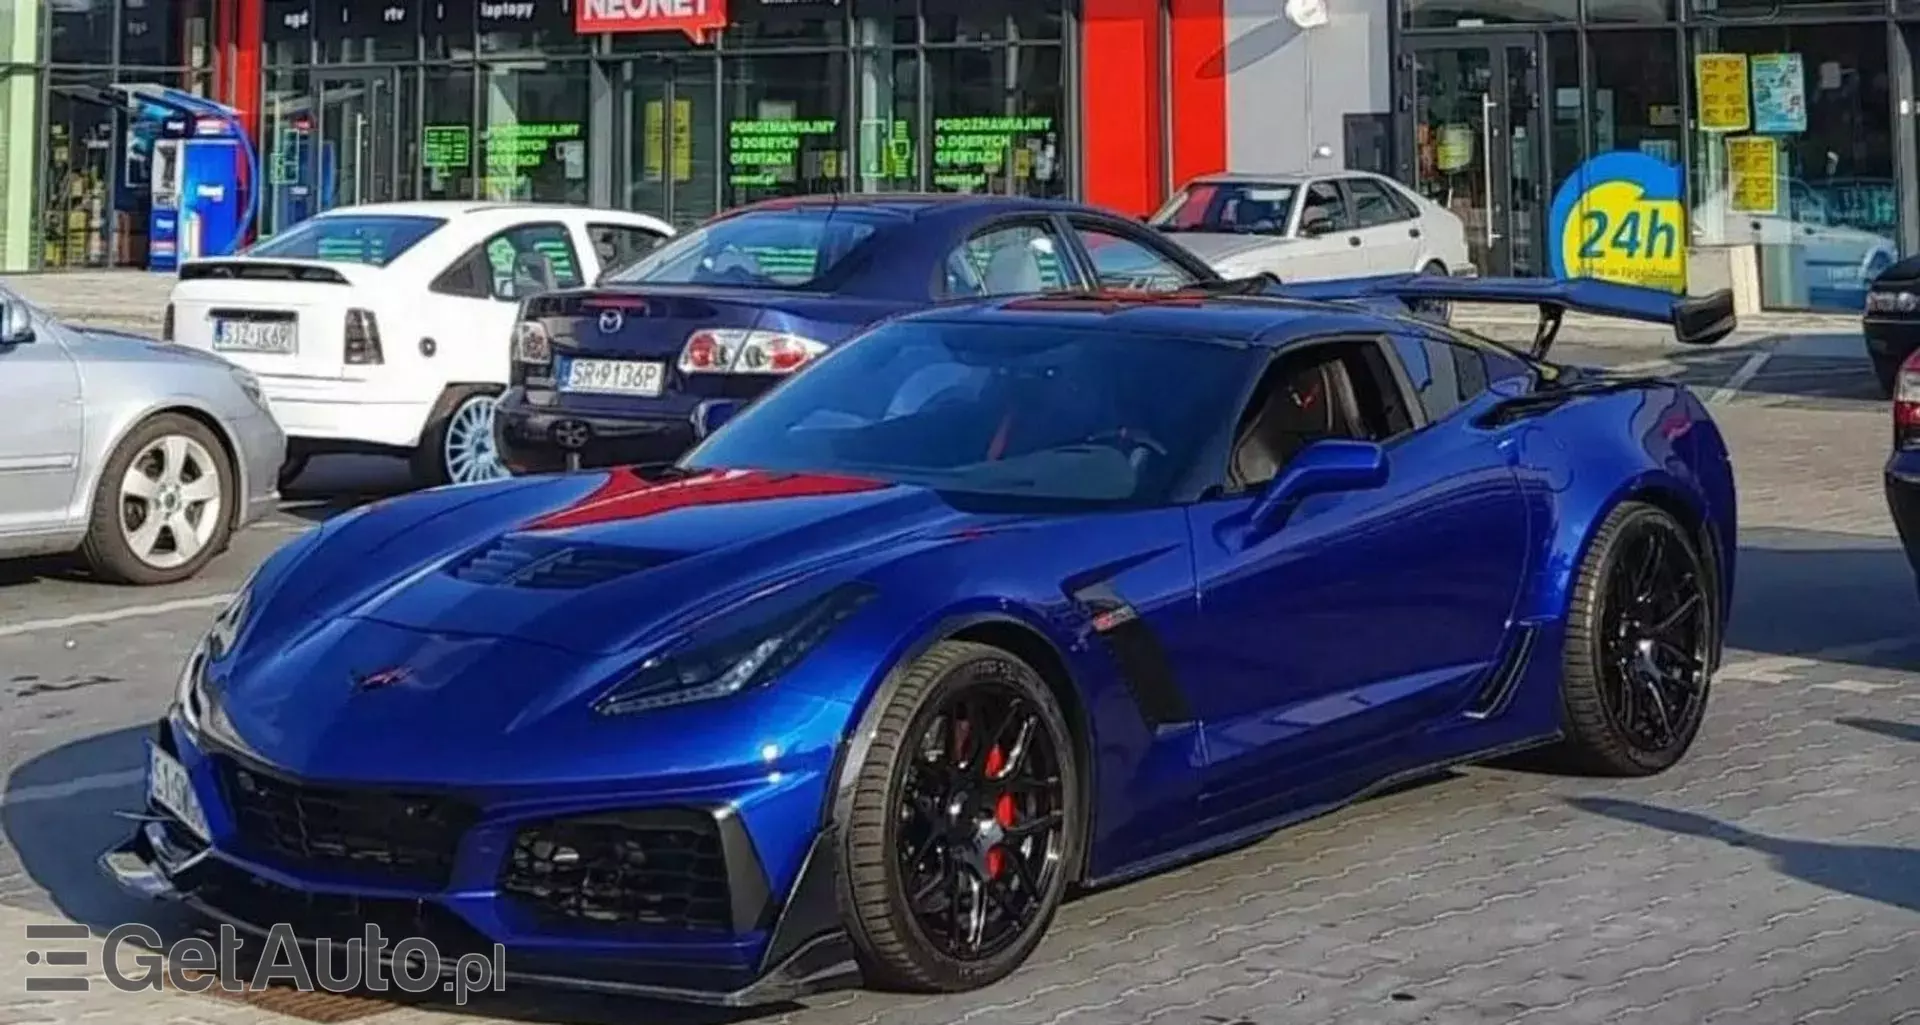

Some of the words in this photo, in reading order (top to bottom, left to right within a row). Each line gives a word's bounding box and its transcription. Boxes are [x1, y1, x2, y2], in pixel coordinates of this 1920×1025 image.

[284, 11, 309, 28] agd
[384, 8, 405, 21] rtv
[480, 2, 535, 19] laptopy
[583, 0, 708, 20] NEONET
[935, 116, 1052, 132] POROZMAWIAJMY
[948, 134, 1011, 148] DOBRYCH
[1578, 209, 1675, 259] 24h
